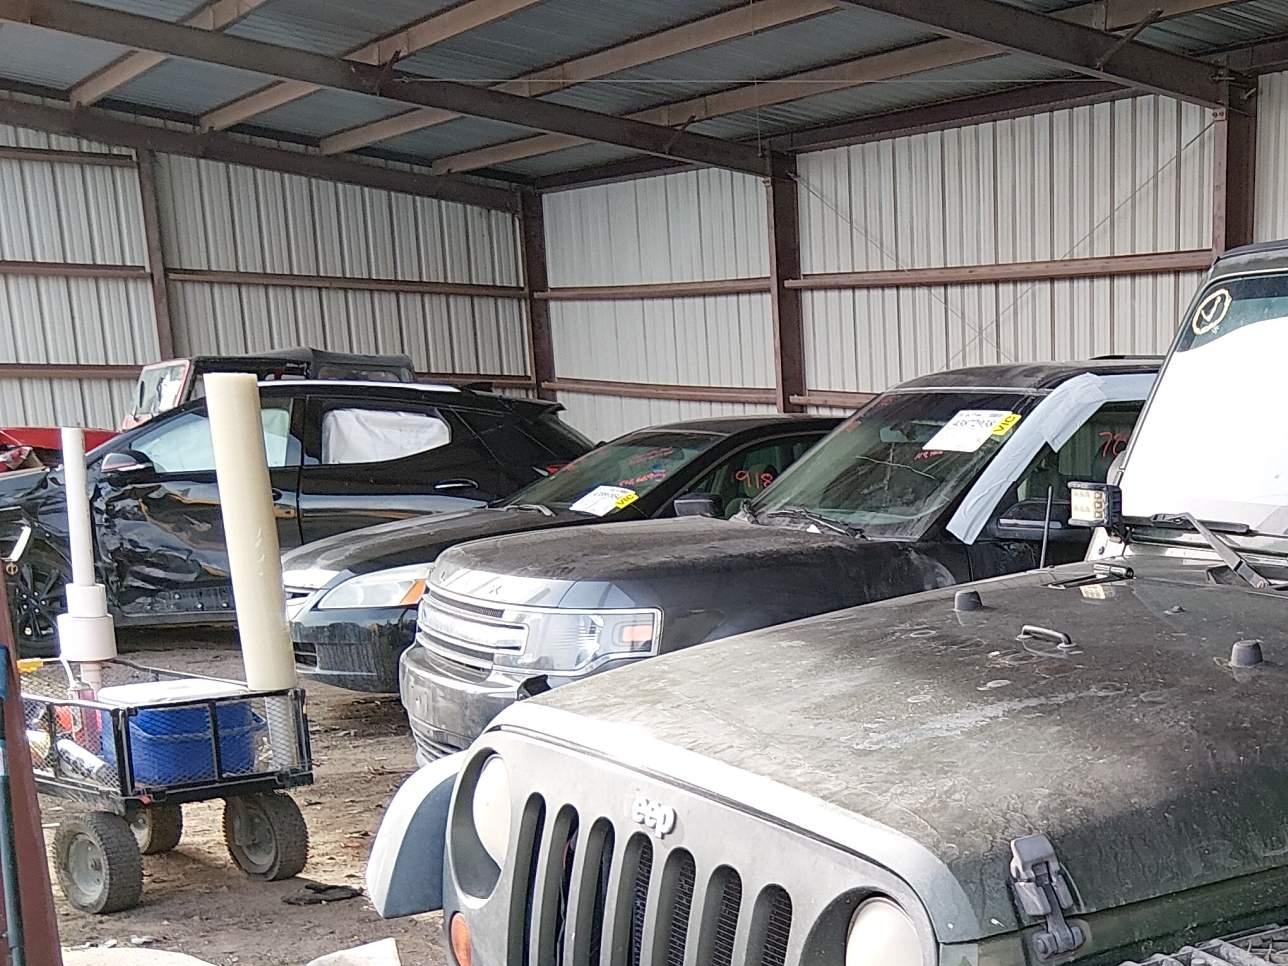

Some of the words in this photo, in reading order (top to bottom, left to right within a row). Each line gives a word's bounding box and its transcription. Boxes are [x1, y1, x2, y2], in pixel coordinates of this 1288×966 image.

[993, 415, 1017, 433] VIC
[735, 470, 774, 488] 918
[623, 793, 678, 840] eep
